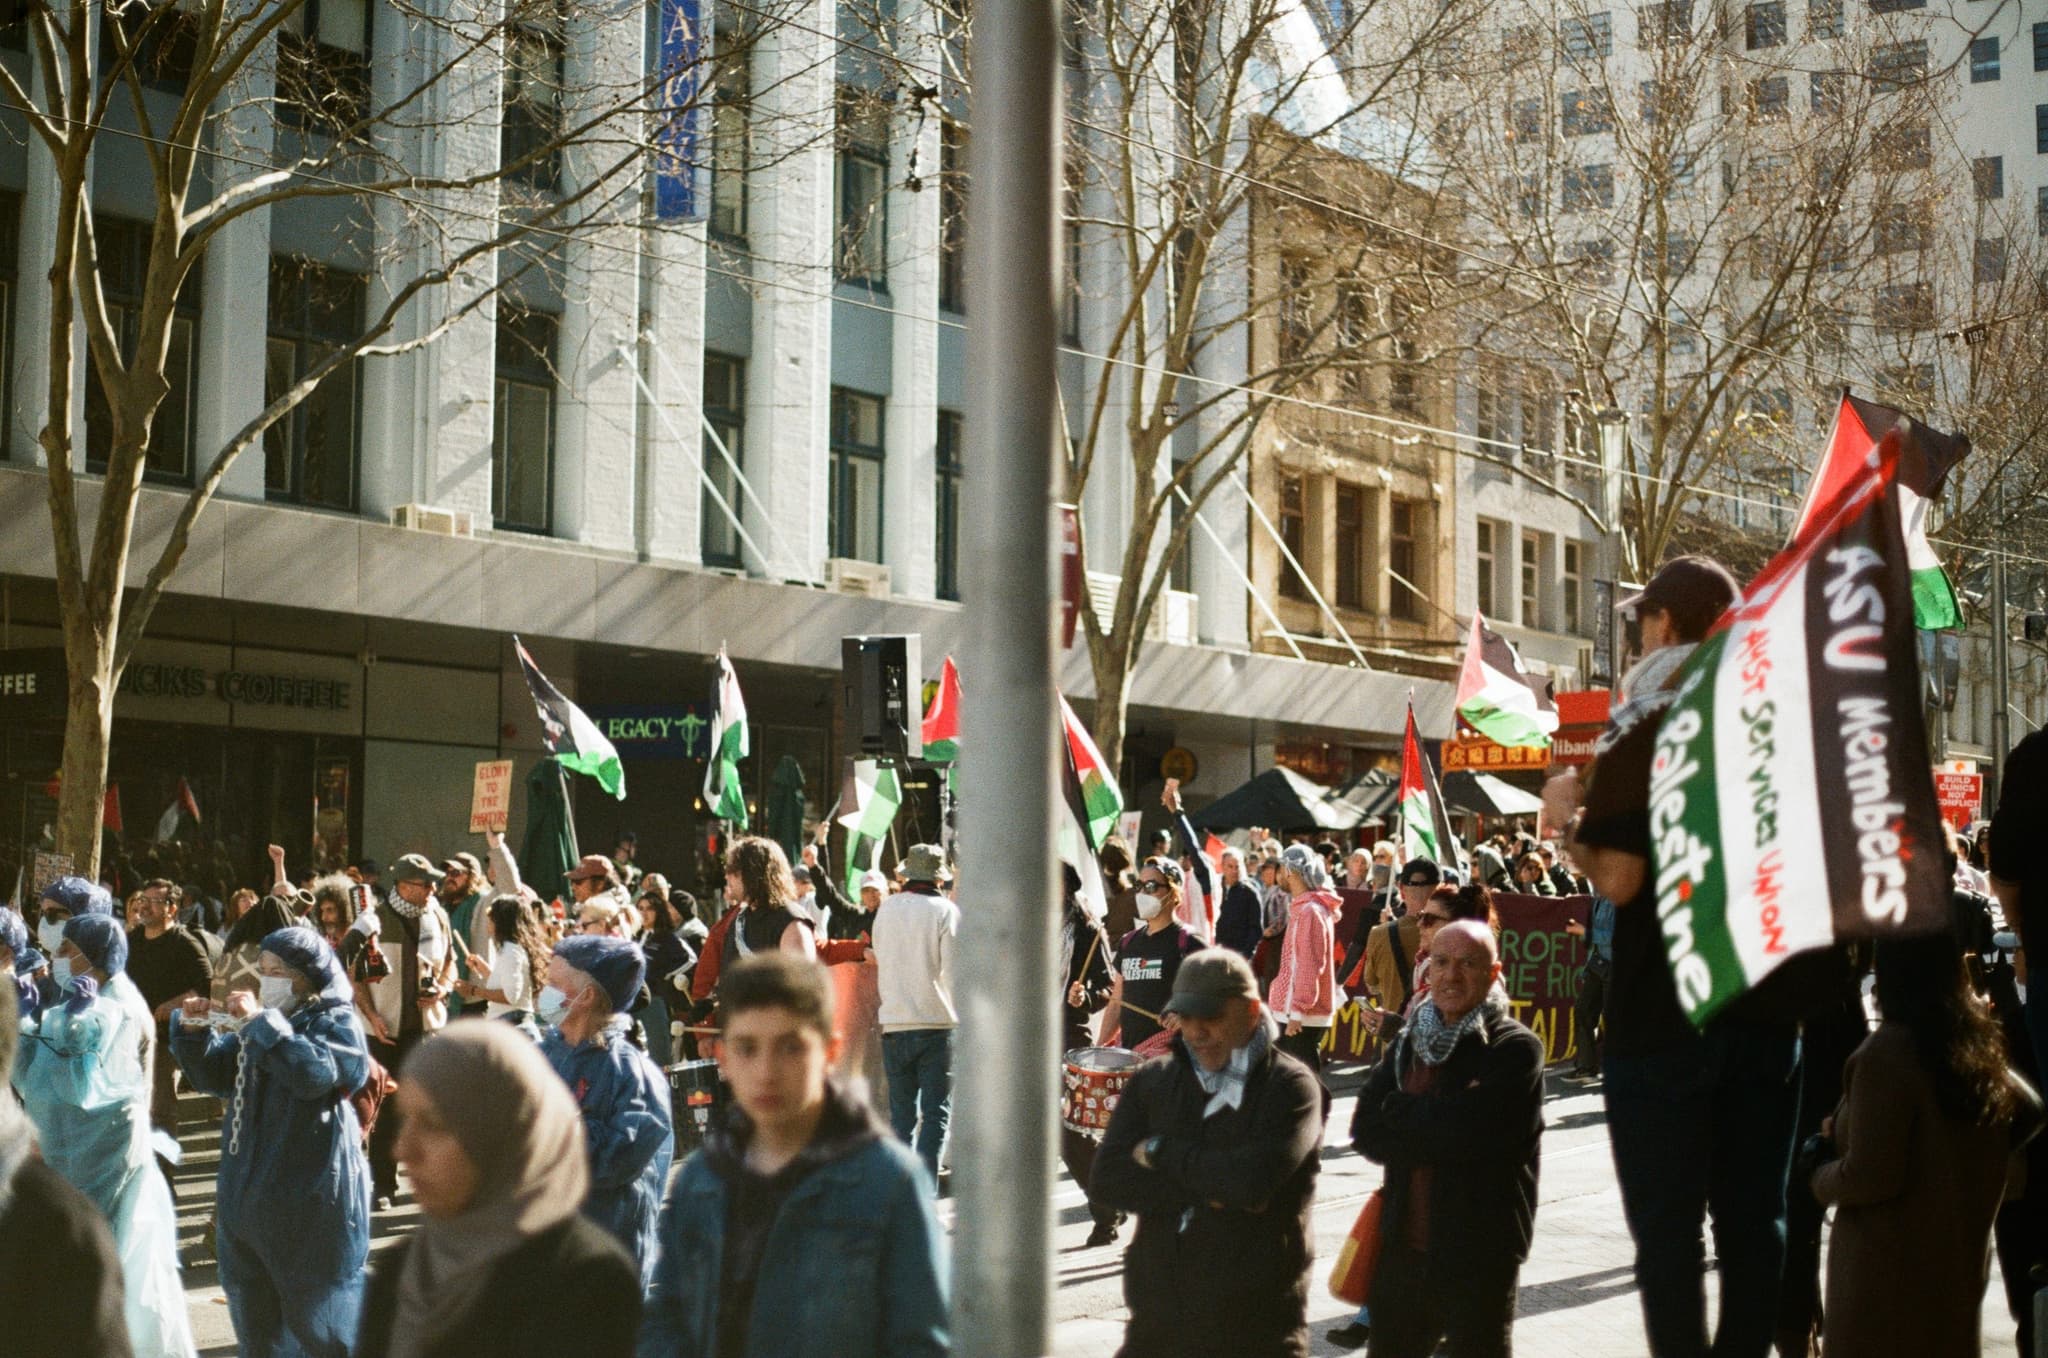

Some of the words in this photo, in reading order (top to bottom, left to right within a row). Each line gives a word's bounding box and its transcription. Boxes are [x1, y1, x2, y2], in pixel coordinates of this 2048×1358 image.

[1968, 329, 1985, 343] 192
[1824, 545, 1887, 671] ASU
[0, 673, 36, 695] FEE
[215, 670, 352, 710] COFFEE
[480, 765, 508, 779] GLORY
[1943, 775, 1971, 784] BUILD
[486, 781, 497, 793] TO
[1938, 782, 1976, 792] CLINICS
[1947, 790, 1967, 799] NOT
[481, 796, 499, 808] THE
[1837, 697, 1907, 925] Members
[1649, 709, 1713, 1012] Palestine
[1500, 929, 1580, 963] ROFI
[1506, 963, 1538, 998] HE
